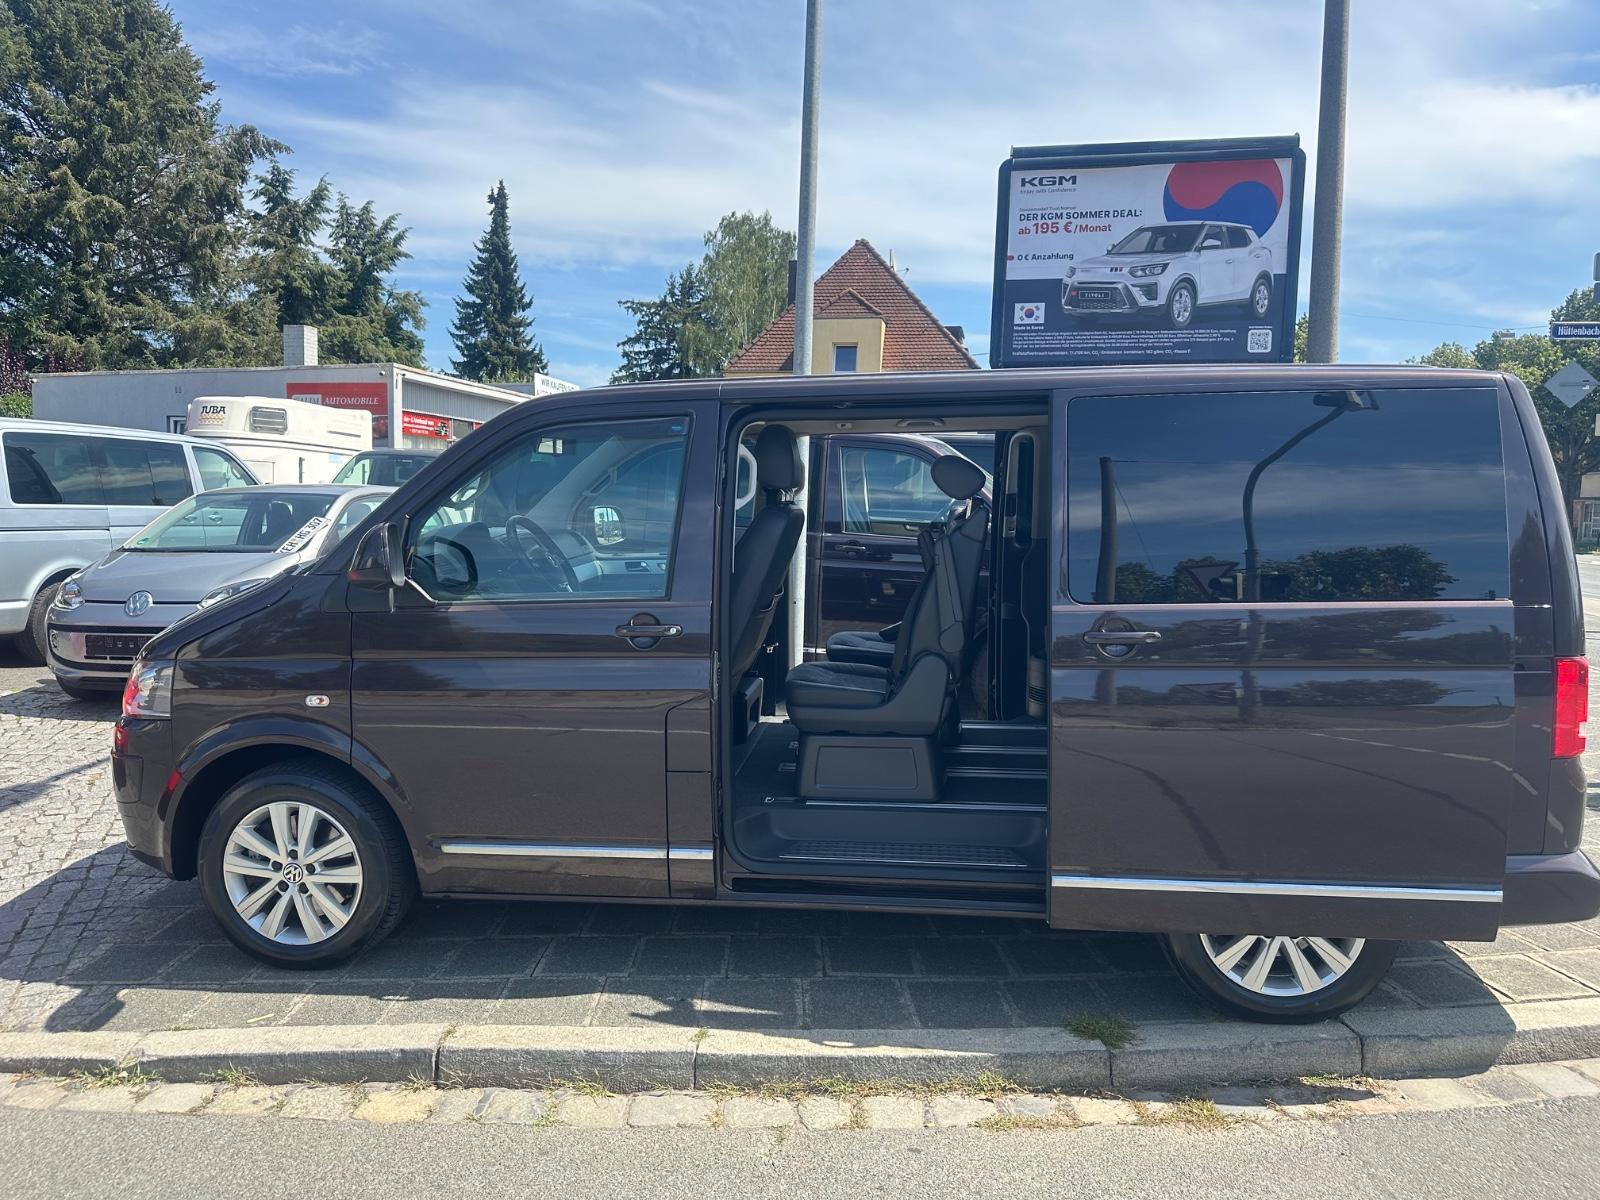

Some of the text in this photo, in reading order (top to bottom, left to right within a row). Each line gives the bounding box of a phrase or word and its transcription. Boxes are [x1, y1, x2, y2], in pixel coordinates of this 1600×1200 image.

[1021, 175, 1077, 187] KGM
[1019, 209, 1143, 222] DER KGM SOMMER DEAL:
[1018, 226, 1031, 235] ab
[1033, 221, 1060, 235] 195
[1031, 253, 1074, 262] Anzahlung
[324, 397, 380, 405] AUTOMOBILE
